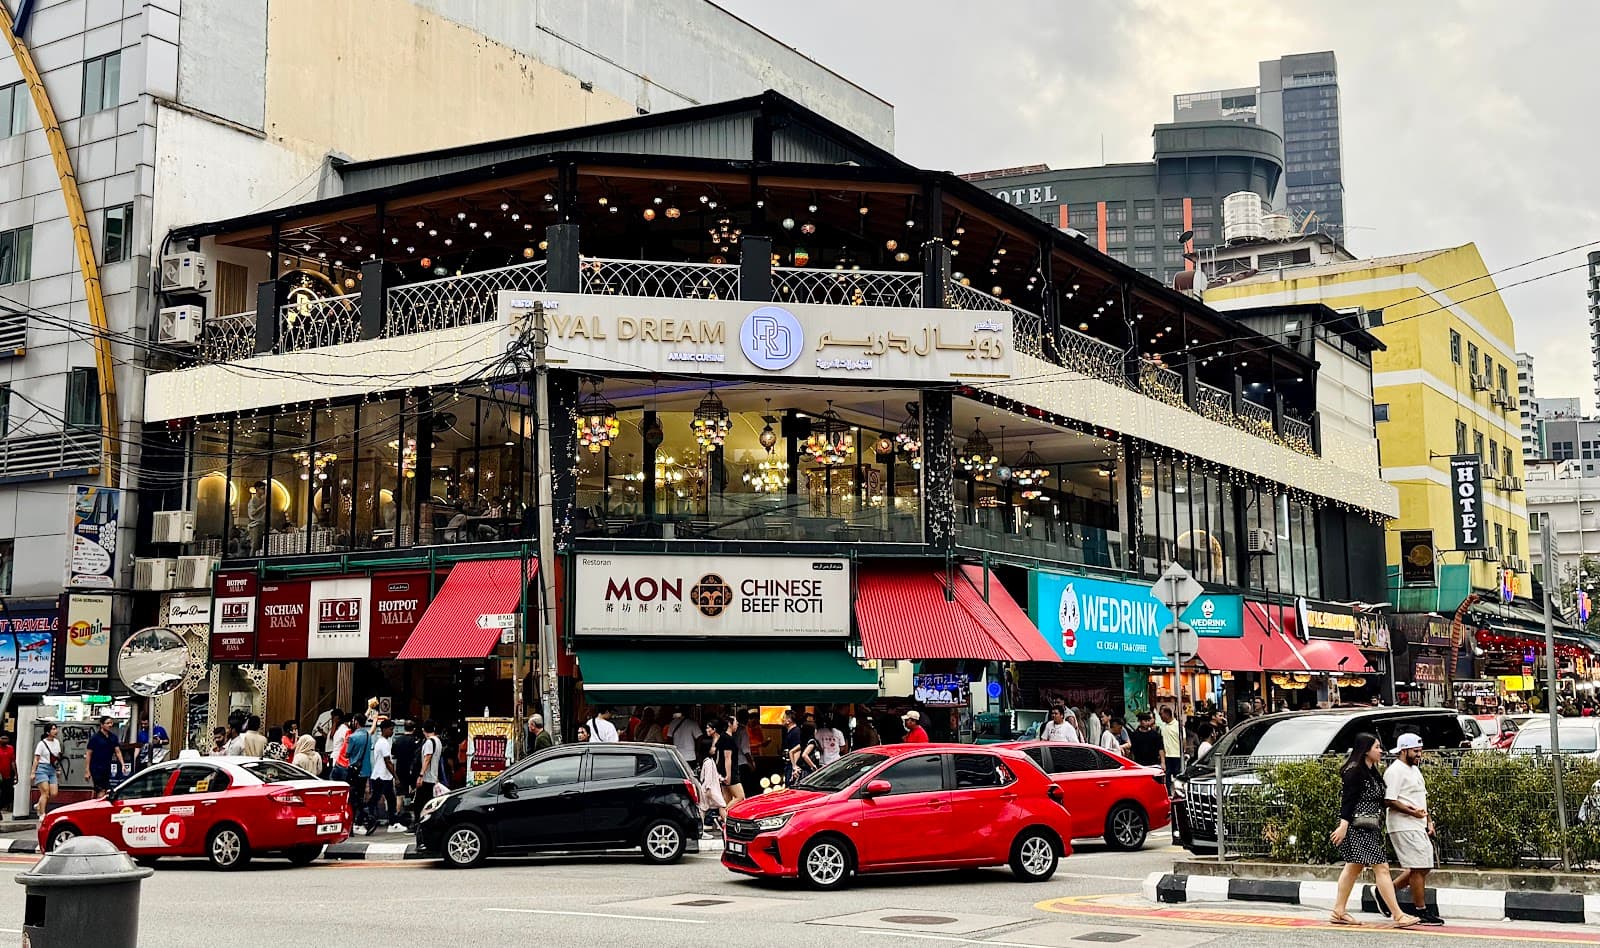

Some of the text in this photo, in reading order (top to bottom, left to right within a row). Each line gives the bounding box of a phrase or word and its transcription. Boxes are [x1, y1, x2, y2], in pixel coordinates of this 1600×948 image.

[989, 186, 1057, 205] OTEL
[617, 316, 726, 344] DREAM
[1457, 466, 1477, 544] HOTEL
[582, 558, 612, 566] Restoran
[605, 576, 683, 601] MON
[740, 579, 823, 597] CHINESE
[264, 603, 304, 616] SICHUAN
[378, 599, 418, 612] HOTPOT
[741, 598, 823, 613] BEEF ROTI
[269, 615, 297, 628] RASA
[381, 611, 414, 625] MALA
[1082, 593, 1159, 638] WEDRINK
[1190, 618, 1227, 627] WEDRINK
[69, 618, 103, 639] Sunbit
[64, 666, 83, 674] BUKA
[127, 825, 156, 834] airasia
